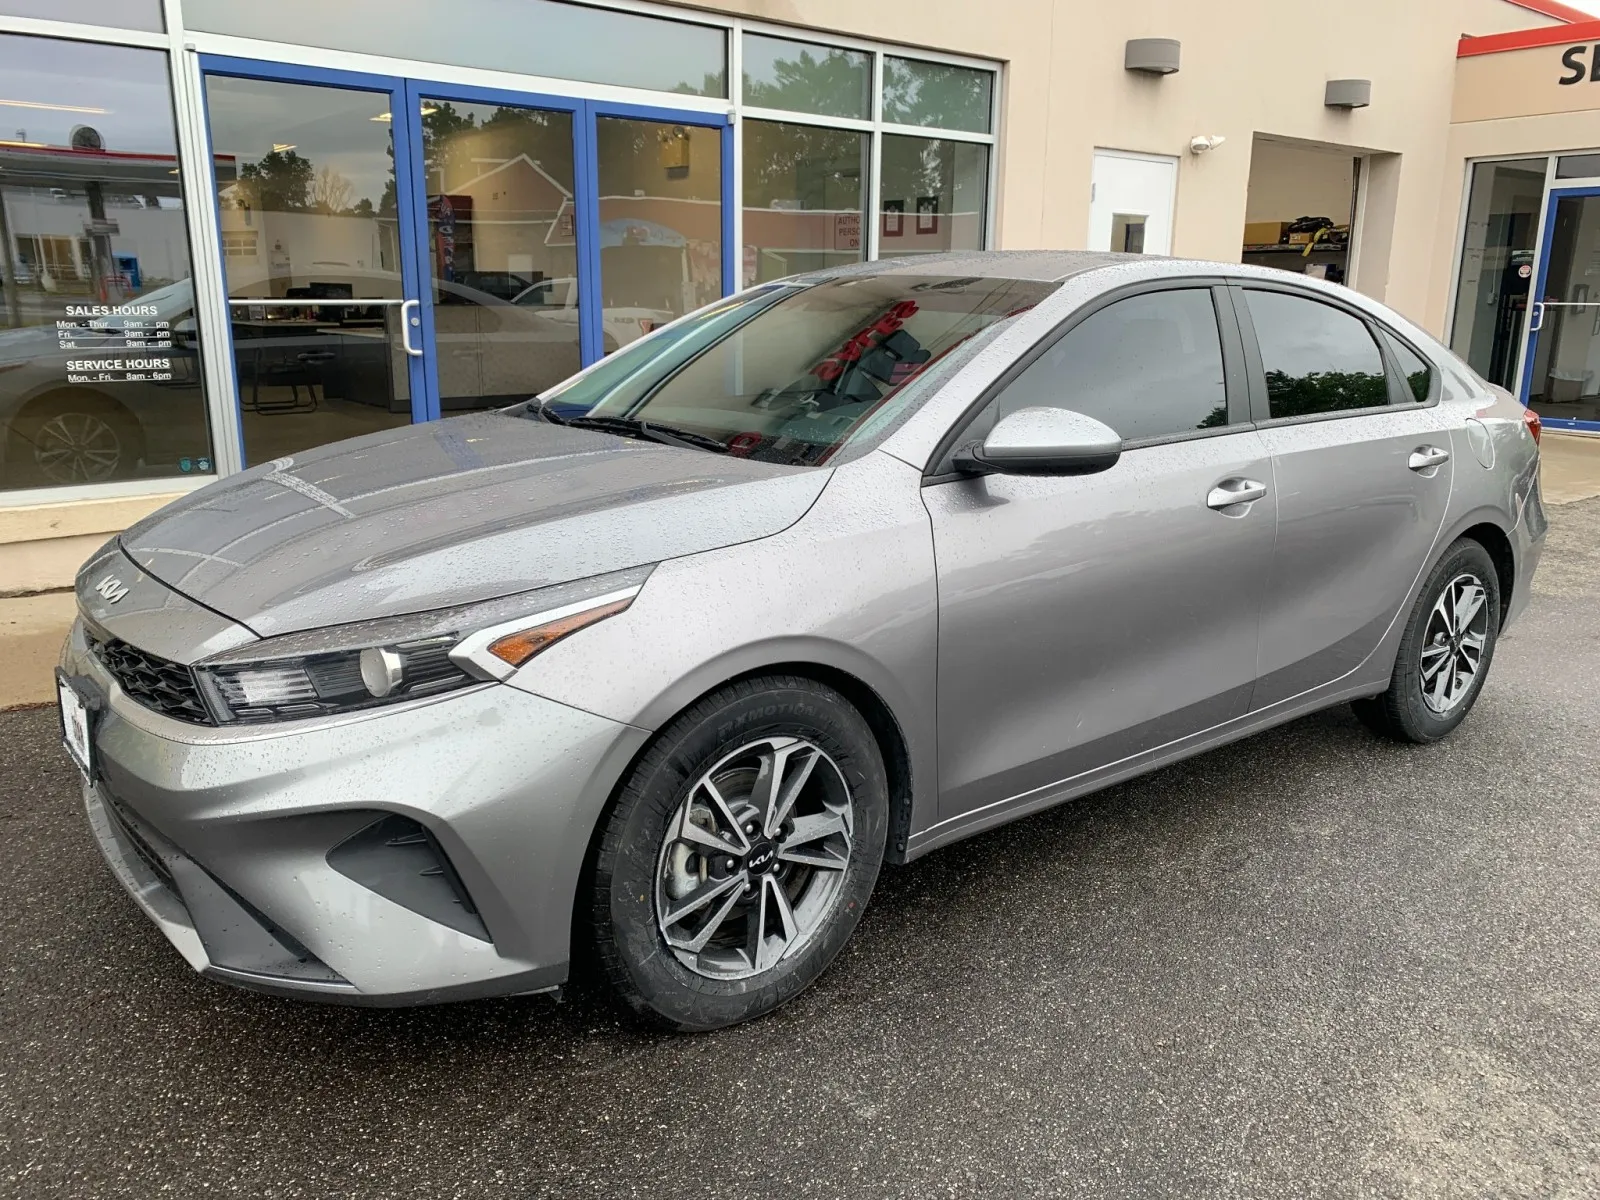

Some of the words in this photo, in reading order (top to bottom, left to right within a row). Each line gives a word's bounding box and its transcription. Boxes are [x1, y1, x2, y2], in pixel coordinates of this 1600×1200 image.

[65, 305, 109, 316] SALES
[112, 305, 158, 316] HOURS
[56, 320, 80, 329] Mon.
[88, 320, 111, 328] Thur.
[123, 320, 143, 328] 9am
[155, 321, 169, 329] pm
[57, 330, 73, 339] Fri.
[124, 330, 144, 338] 9am
[156, 331, 170, 339] pm
[59, 340, 78, 349] Sat.
[126, 340, 146, 348] 9am
[158, 340, 172, 348] pm
[66, 359, 123, 370] SERVICE
[125, 358, 170, 369] HOURS
[67, 374, 91, 383] Mon.
[98, 373, 114, 381] Fri.
[126, 372, 145, 380] 8am
[152, 372, 172, 380] 6pm
